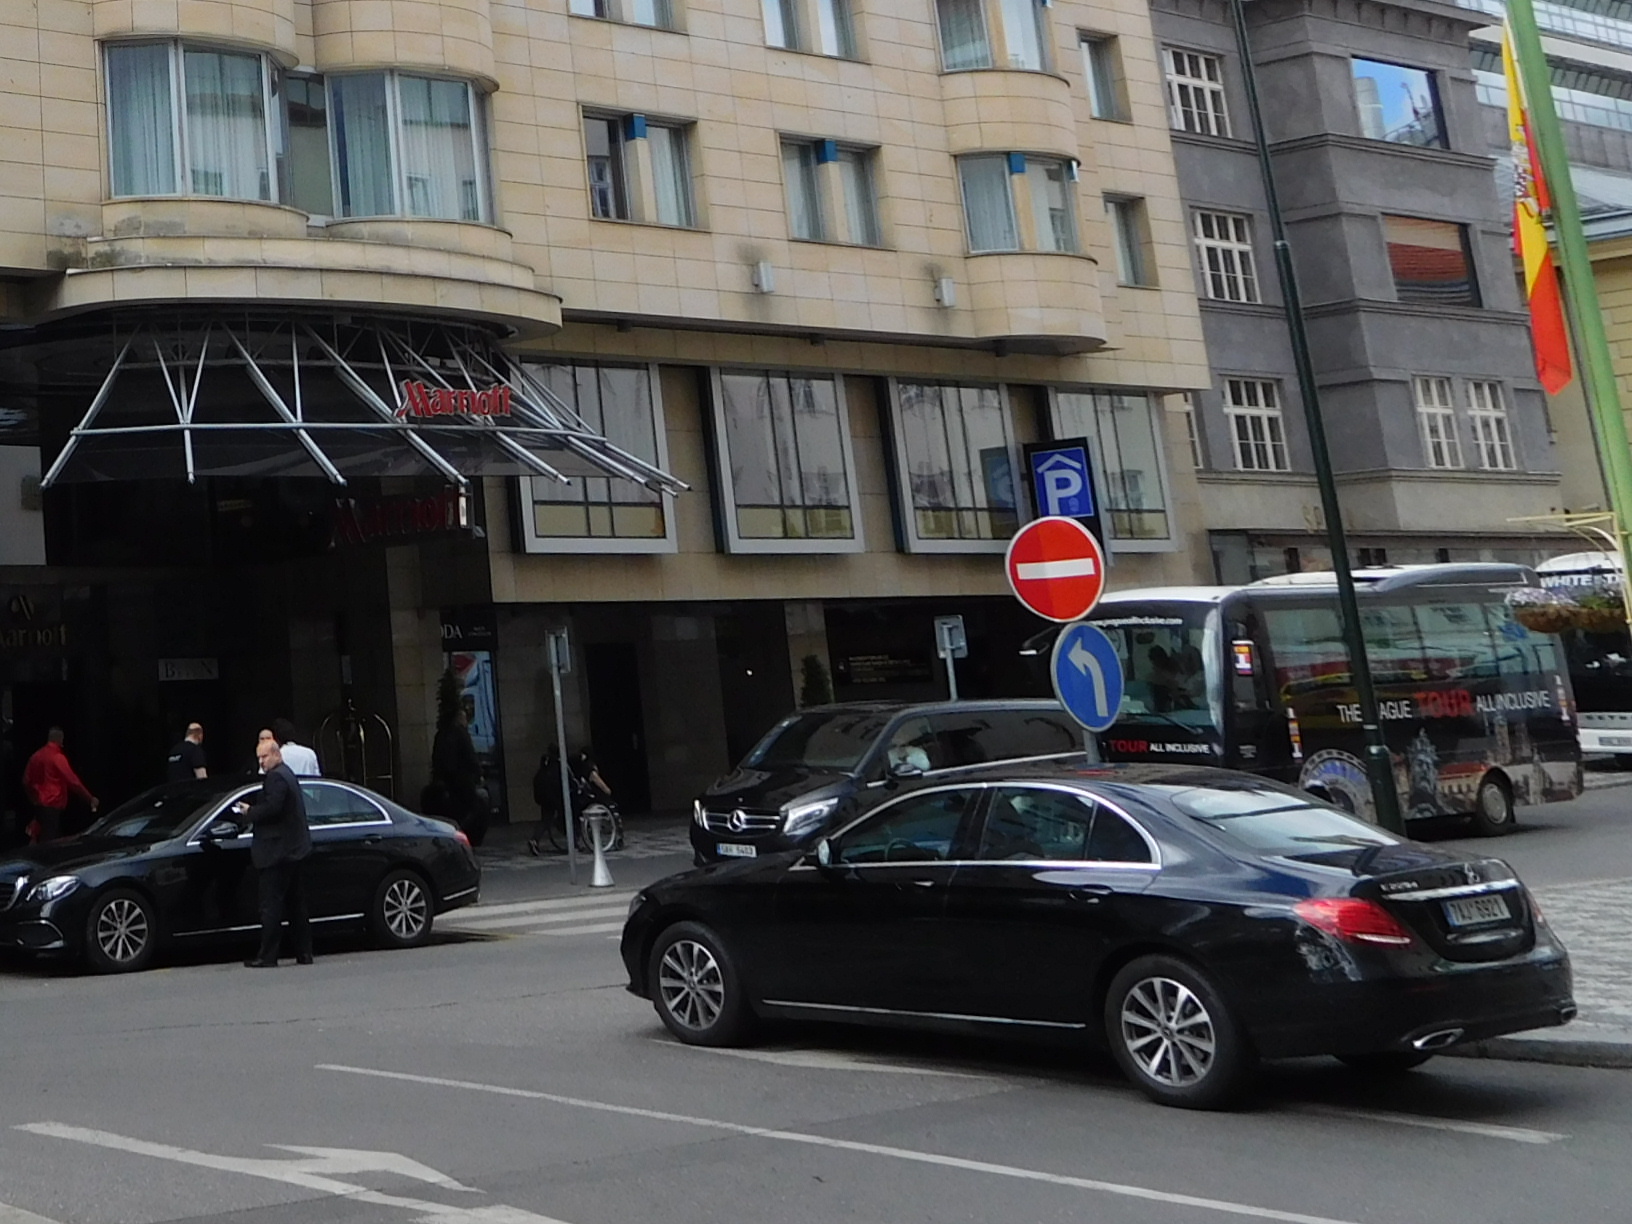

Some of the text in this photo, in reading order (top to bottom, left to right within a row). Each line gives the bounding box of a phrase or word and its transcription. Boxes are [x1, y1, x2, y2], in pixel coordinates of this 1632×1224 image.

[393, 379, 511, 417] Marriott
[1044, 469, 1082, 515] P
[1336, 704, 1363, 722] THE
[1379, 699, 1413, 720] AGUE
[1414, 689, 1474, 718] TOUR
[1476, 694, 1496, 712] ALL
[1110, 739, 1211, 755] TOUR ALL INCLUSIVE
